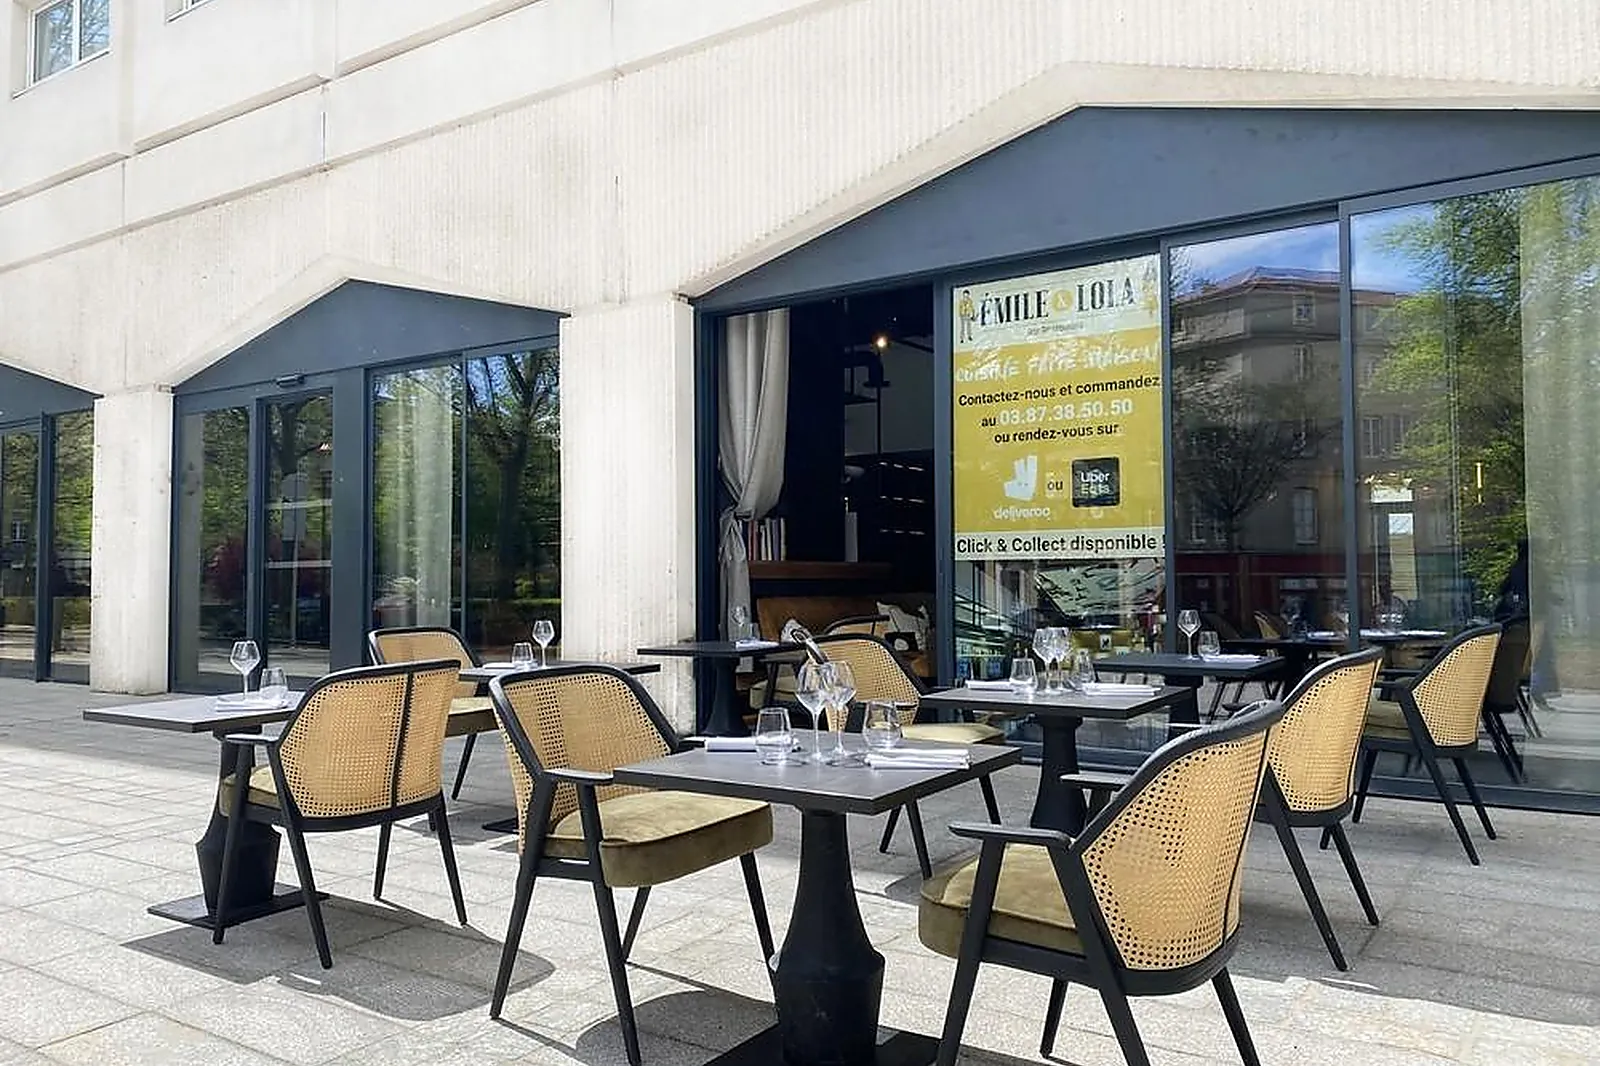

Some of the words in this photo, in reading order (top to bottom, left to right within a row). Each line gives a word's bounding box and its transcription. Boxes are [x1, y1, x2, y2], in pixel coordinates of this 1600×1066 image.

[980, 288, 1049, 327] ÉMILE
[1076, 276, 1136, 313] LOLA
[958, 389, 1056, 406] Contactez-nous
[1060, 384, 1072, 397] et
[1076, 374, 1160, 395] commandez
[981, 415, 997, 428] au
[999, 399, 1133, 425] 03.87.38.50.50
[994, 433, 1010, 443] ou
[1012, 426, 1094, 442] rendez-vous
[1096, 424, 1119, 435] sur
[1047, 481, 1063, 492] ou
[1080, 471, 1110, 483] Uber
[1081, 484, 1110, 495] Eats
[993, 506, 1050, 521] deliveroo
[956, 536, 993, 554] Click
[997, 537, 1008, 552] &
[1011, 536, 1067, 552] Collect
[1070, 532, 1157, 553] disponible
